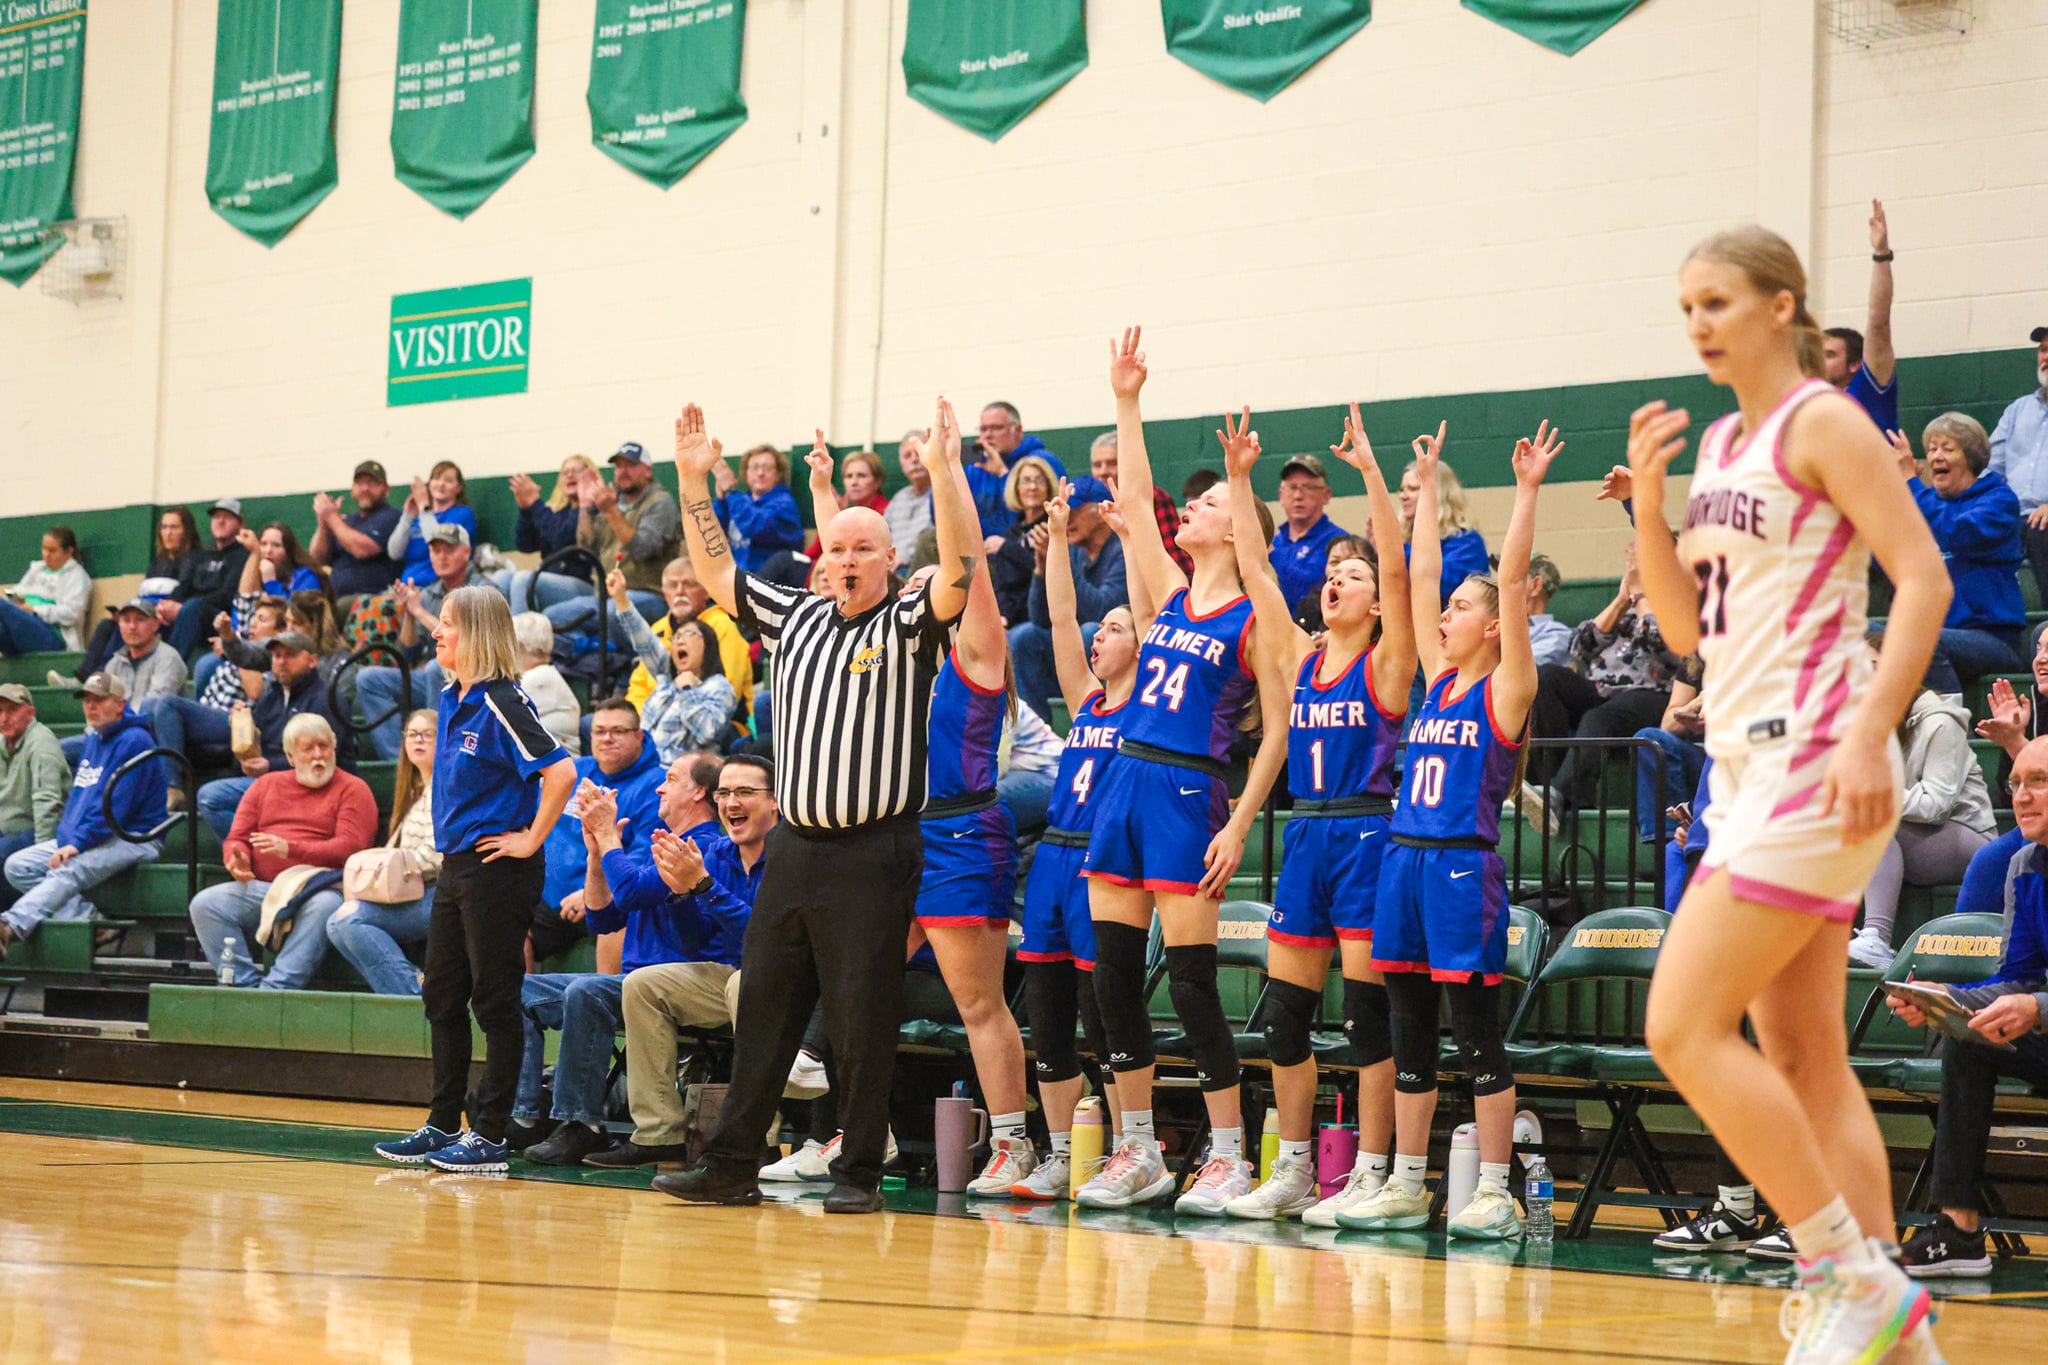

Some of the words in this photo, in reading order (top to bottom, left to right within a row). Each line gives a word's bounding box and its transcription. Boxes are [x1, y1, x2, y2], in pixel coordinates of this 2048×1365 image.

[1223, 14, 1252, 30] State
[1254, 5, 1302, 26] Qualifier
[960, 59, 986, 74] State
[989, 49, 1029, 70] Qualifier
[635, 113, 660, 127] State
[392, 315, 526, 370] VISITOR
[1140, 656, 1192, 713] 24
[1289, 701, 1368, 728] ILMER
[464, 736, 478, 750] G
[1408, 718, 1479, 748] ILMER
[1310, 739, 1325, 793] 1
[1072, 758, 1096, 805] 4
[1410, 755, 1447, 808] 10
[1571, 928, 1665, 949] DODDRIDGE
[1914, 934, 2003, 957] DODDRIDG
